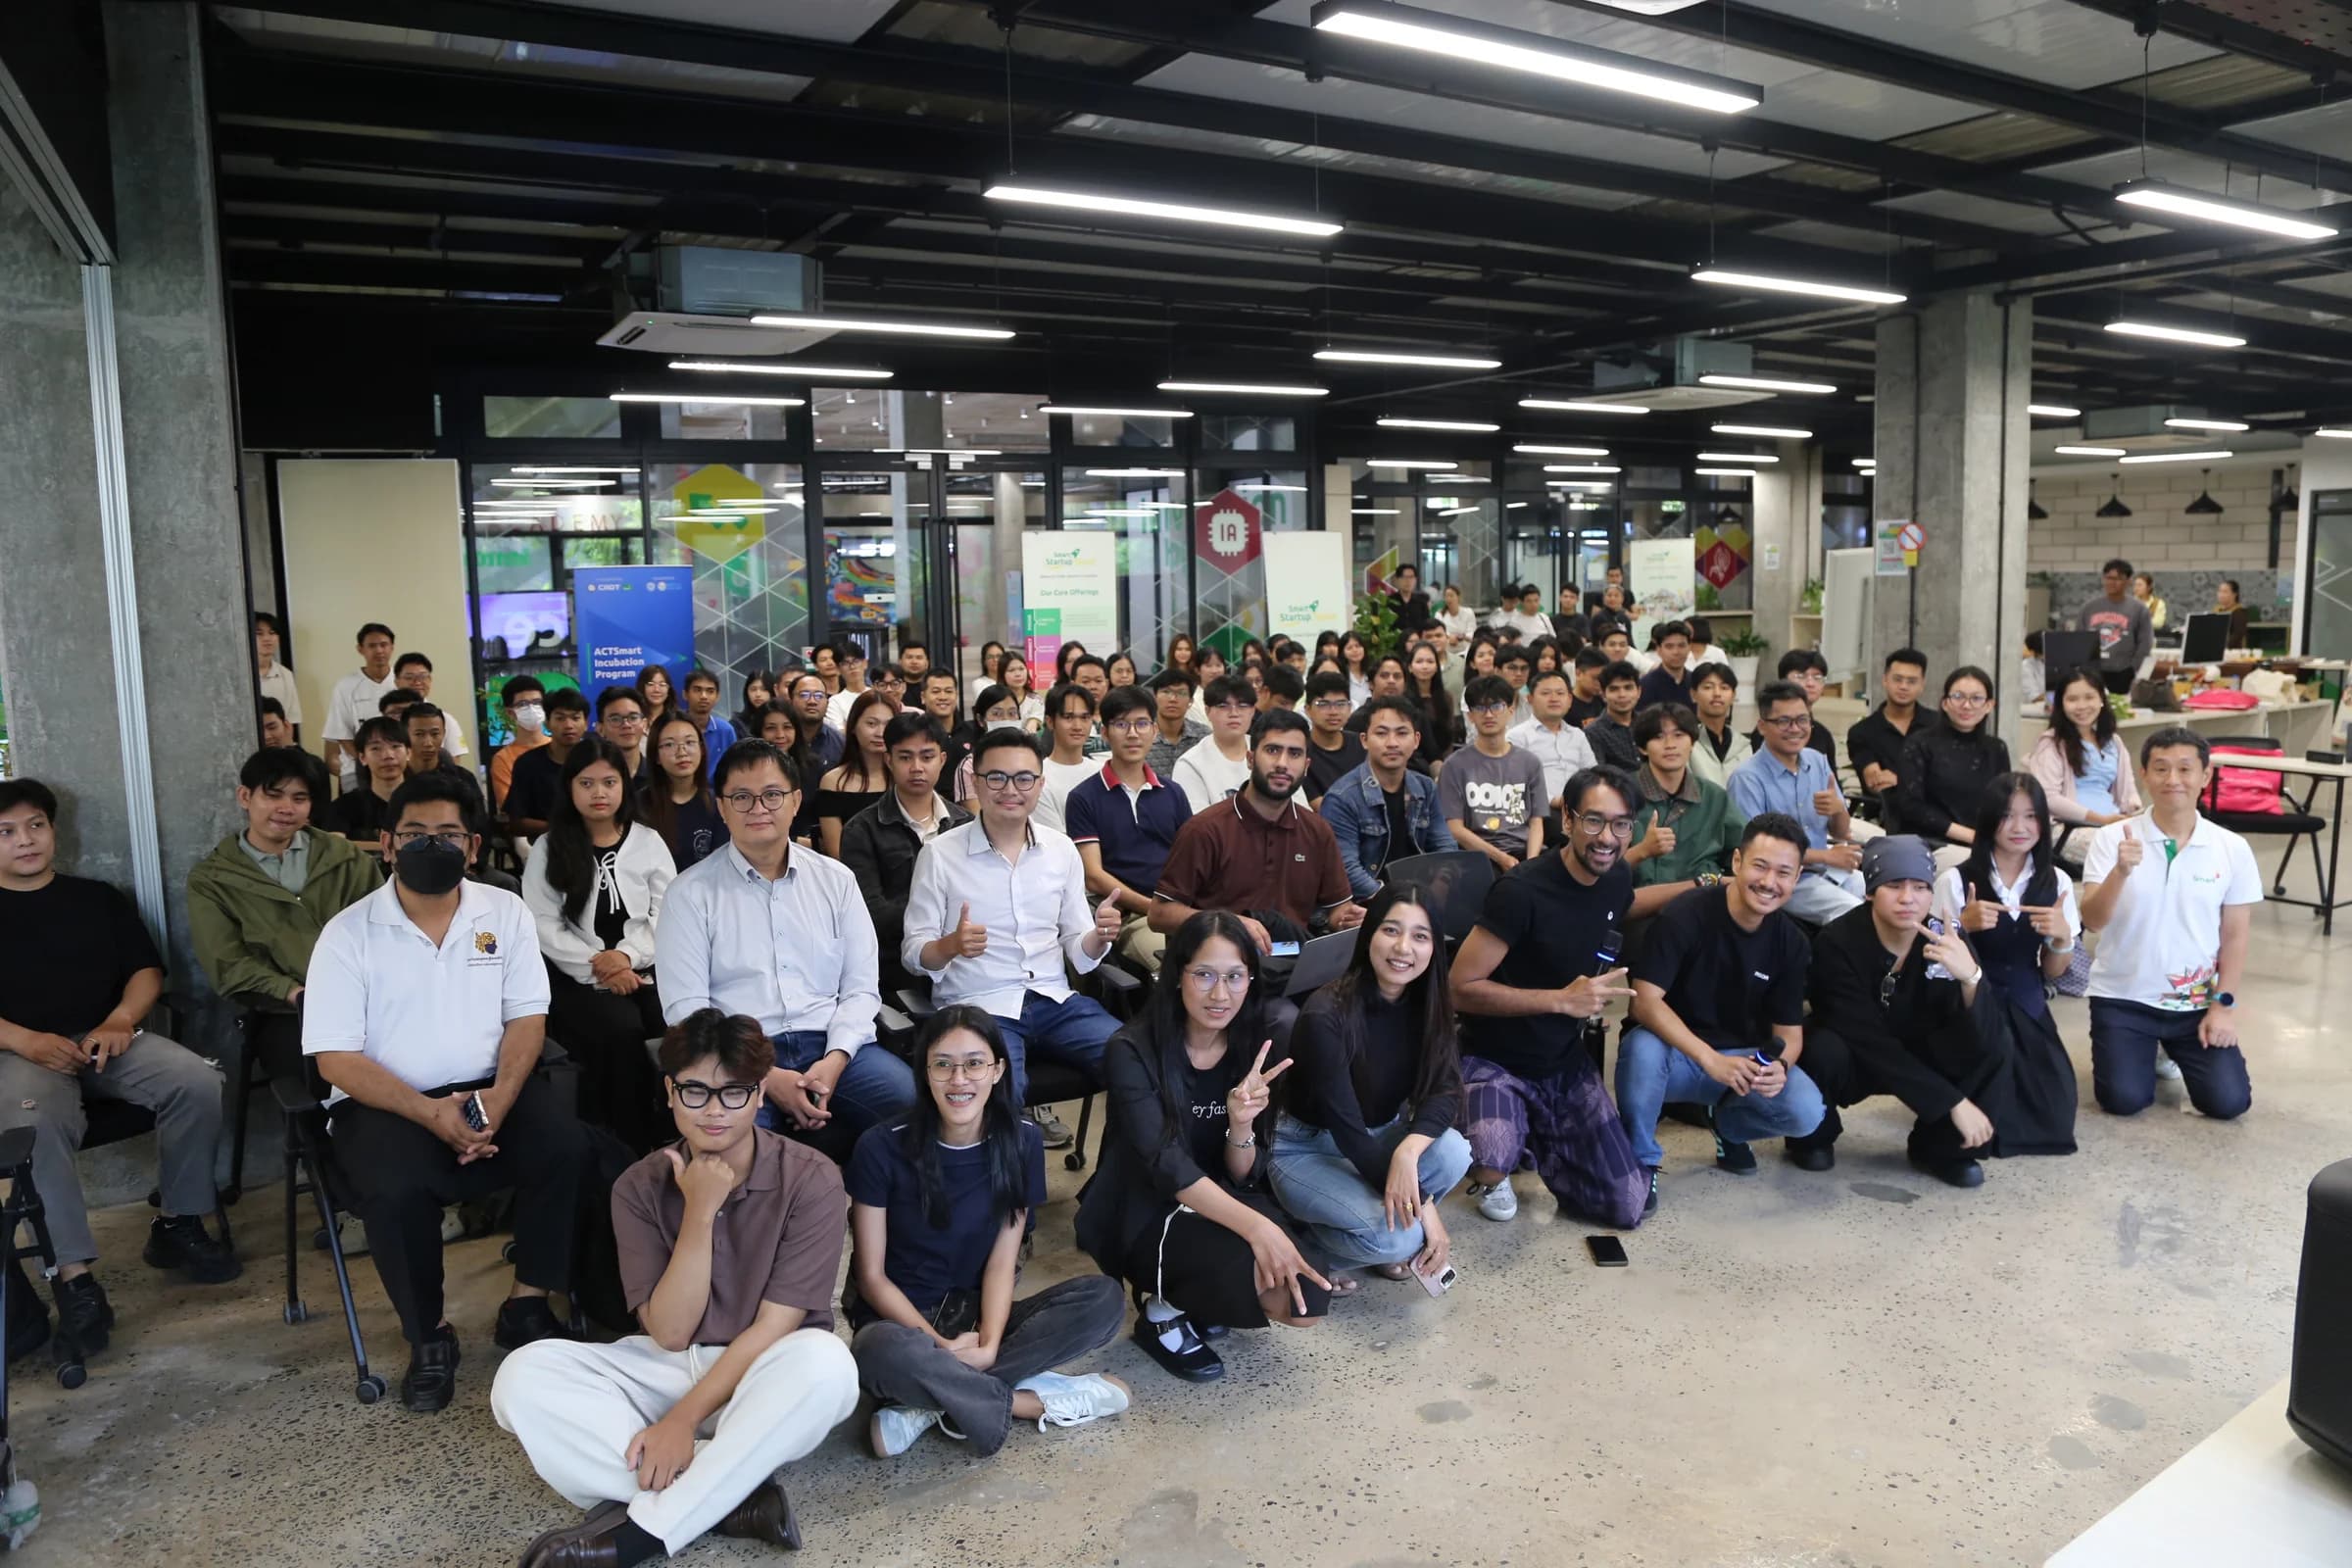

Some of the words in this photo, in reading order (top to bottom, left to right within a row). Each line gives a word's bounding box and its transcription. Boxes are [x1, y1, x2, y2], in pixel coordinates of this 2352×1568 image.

[1045, 558, 1073, 566] Startup
[1280, 612, 1311, 622] Startup
[594, 646, 643, 656] ACTSmart
[594, 658, 645, 667] Incubation
[595, 670, 636, 680] Program
[1192, 1102, 1206, 1118] ey
[1206, 1101, 1227, 1119] fas
